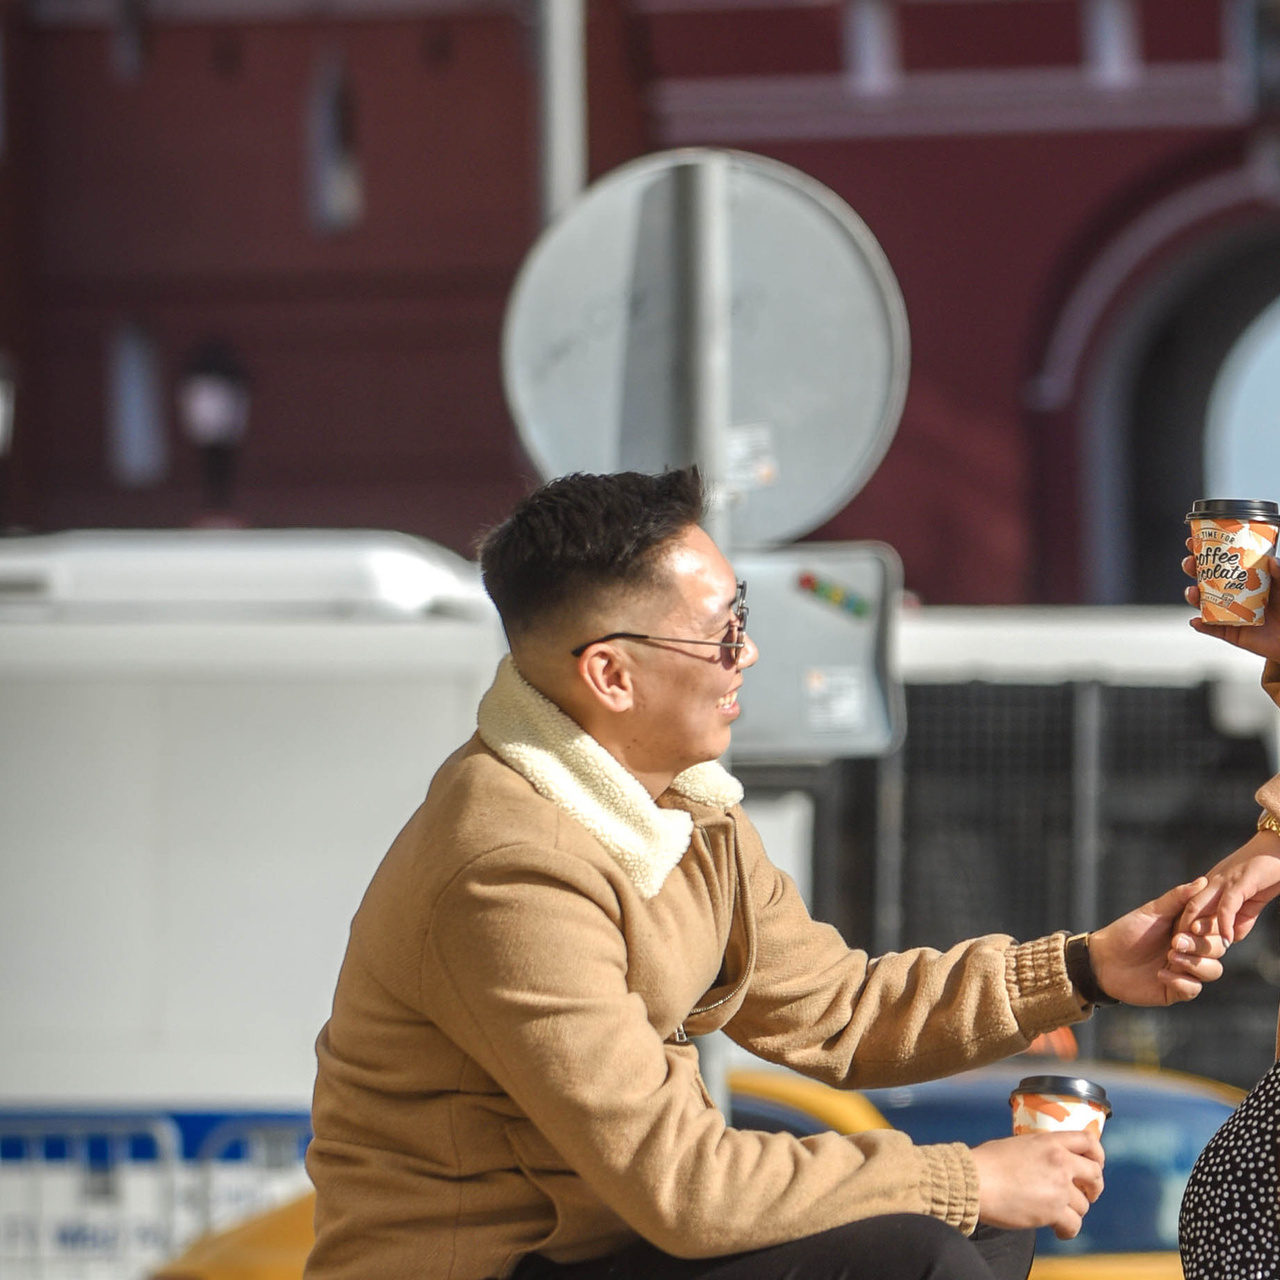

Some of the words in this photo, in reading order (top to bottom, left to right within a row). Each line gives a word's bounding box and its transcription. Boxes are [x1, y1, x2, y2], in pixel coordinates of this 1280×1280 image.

[1201, 530, 1217, 539] TIME
[1220, 533, 1235, 544] FOR
[1224, 580, 1244, 590] tea
